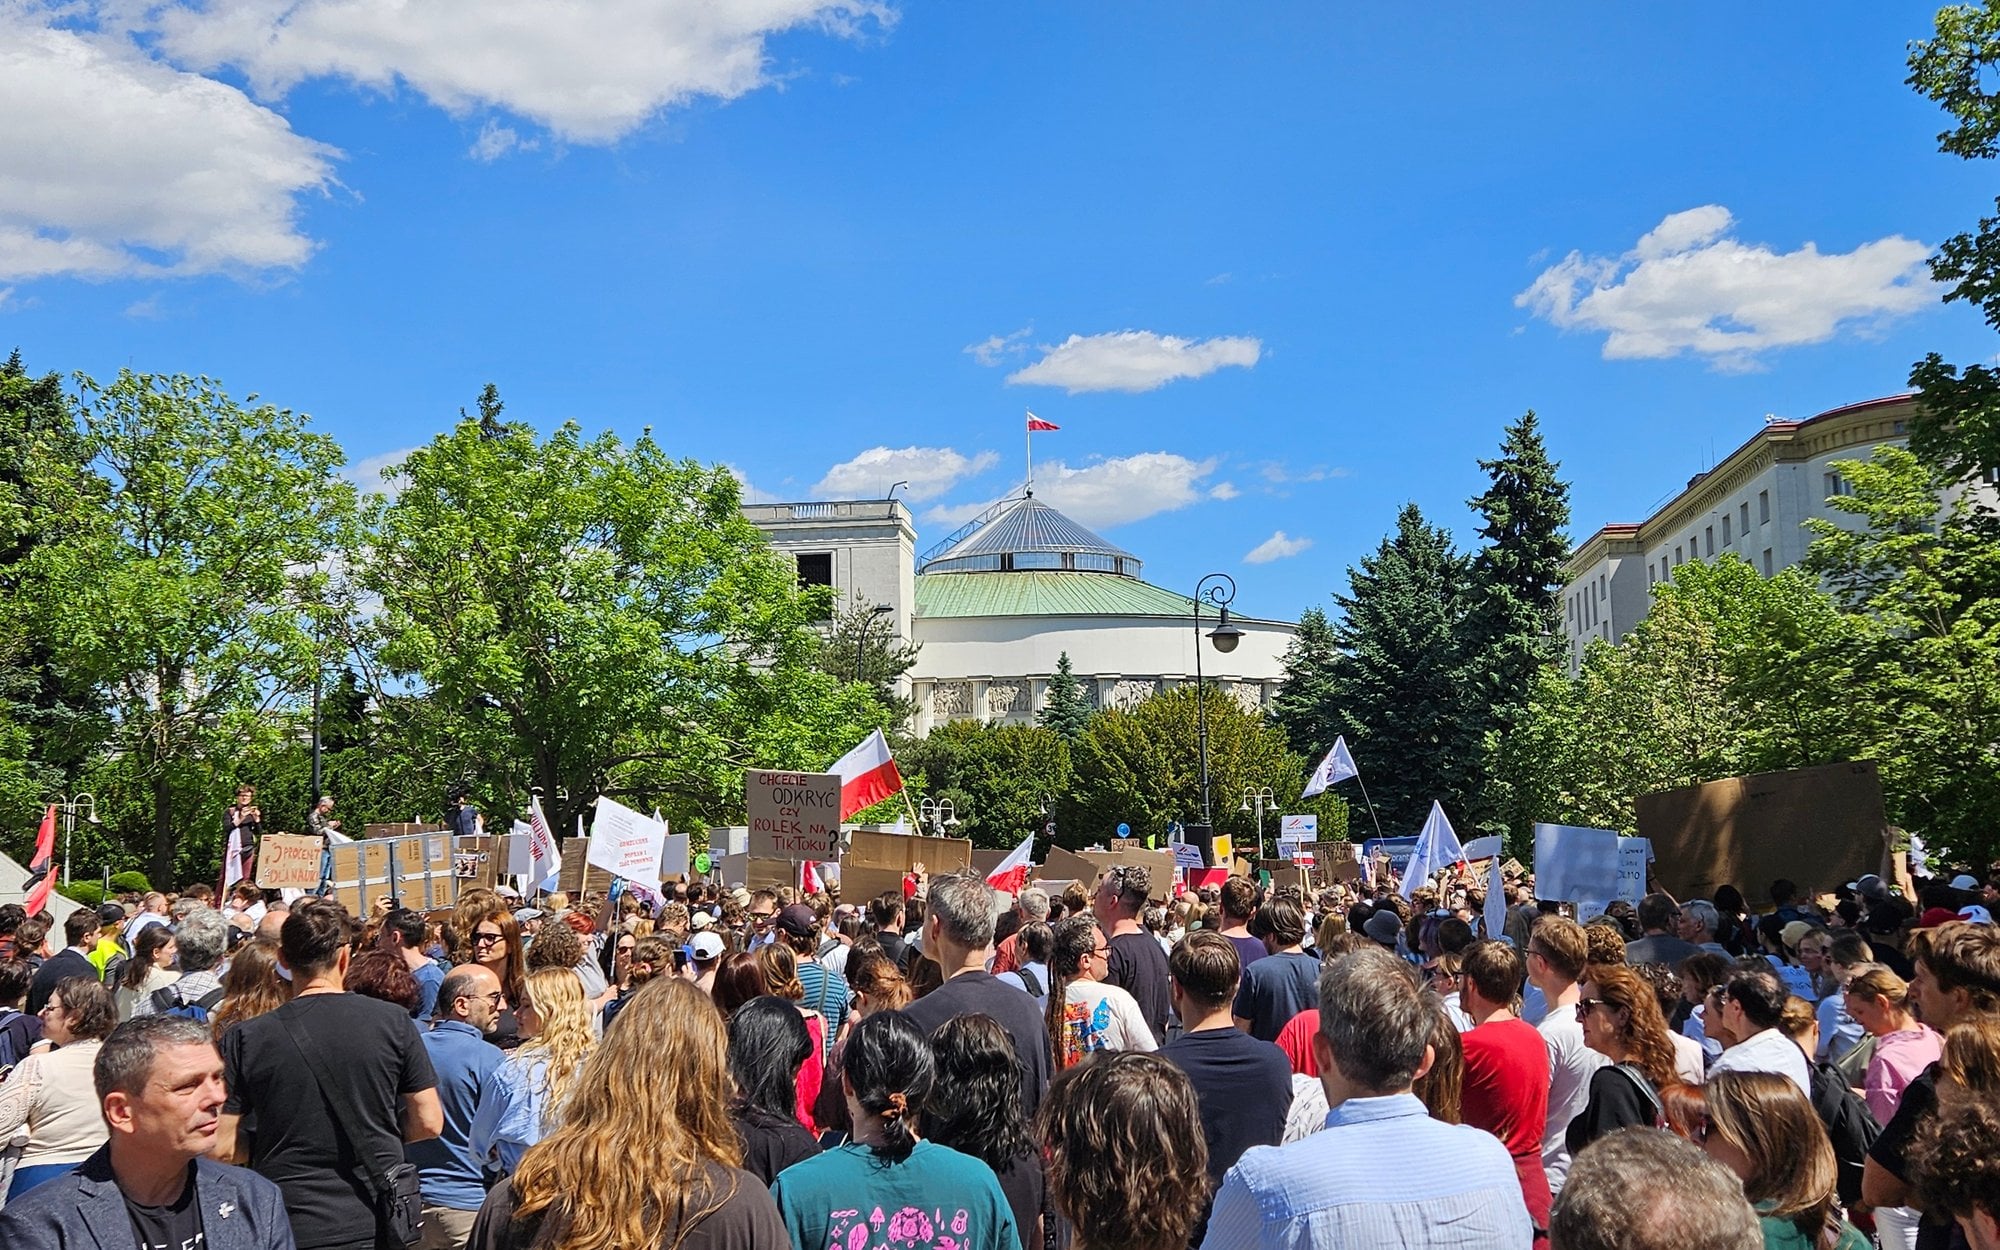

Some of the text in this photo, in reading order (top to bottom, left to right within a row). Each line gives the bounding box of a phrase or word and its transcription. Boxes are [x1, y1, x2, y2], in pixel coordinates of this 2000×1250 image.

[759, 774, 807, 786] CHCECIE
[773, 787, 835, 808] ODKRYĆ
[780, 807, 800, 818] CZY
[754, 817, 826, 834] ROLEK NA
